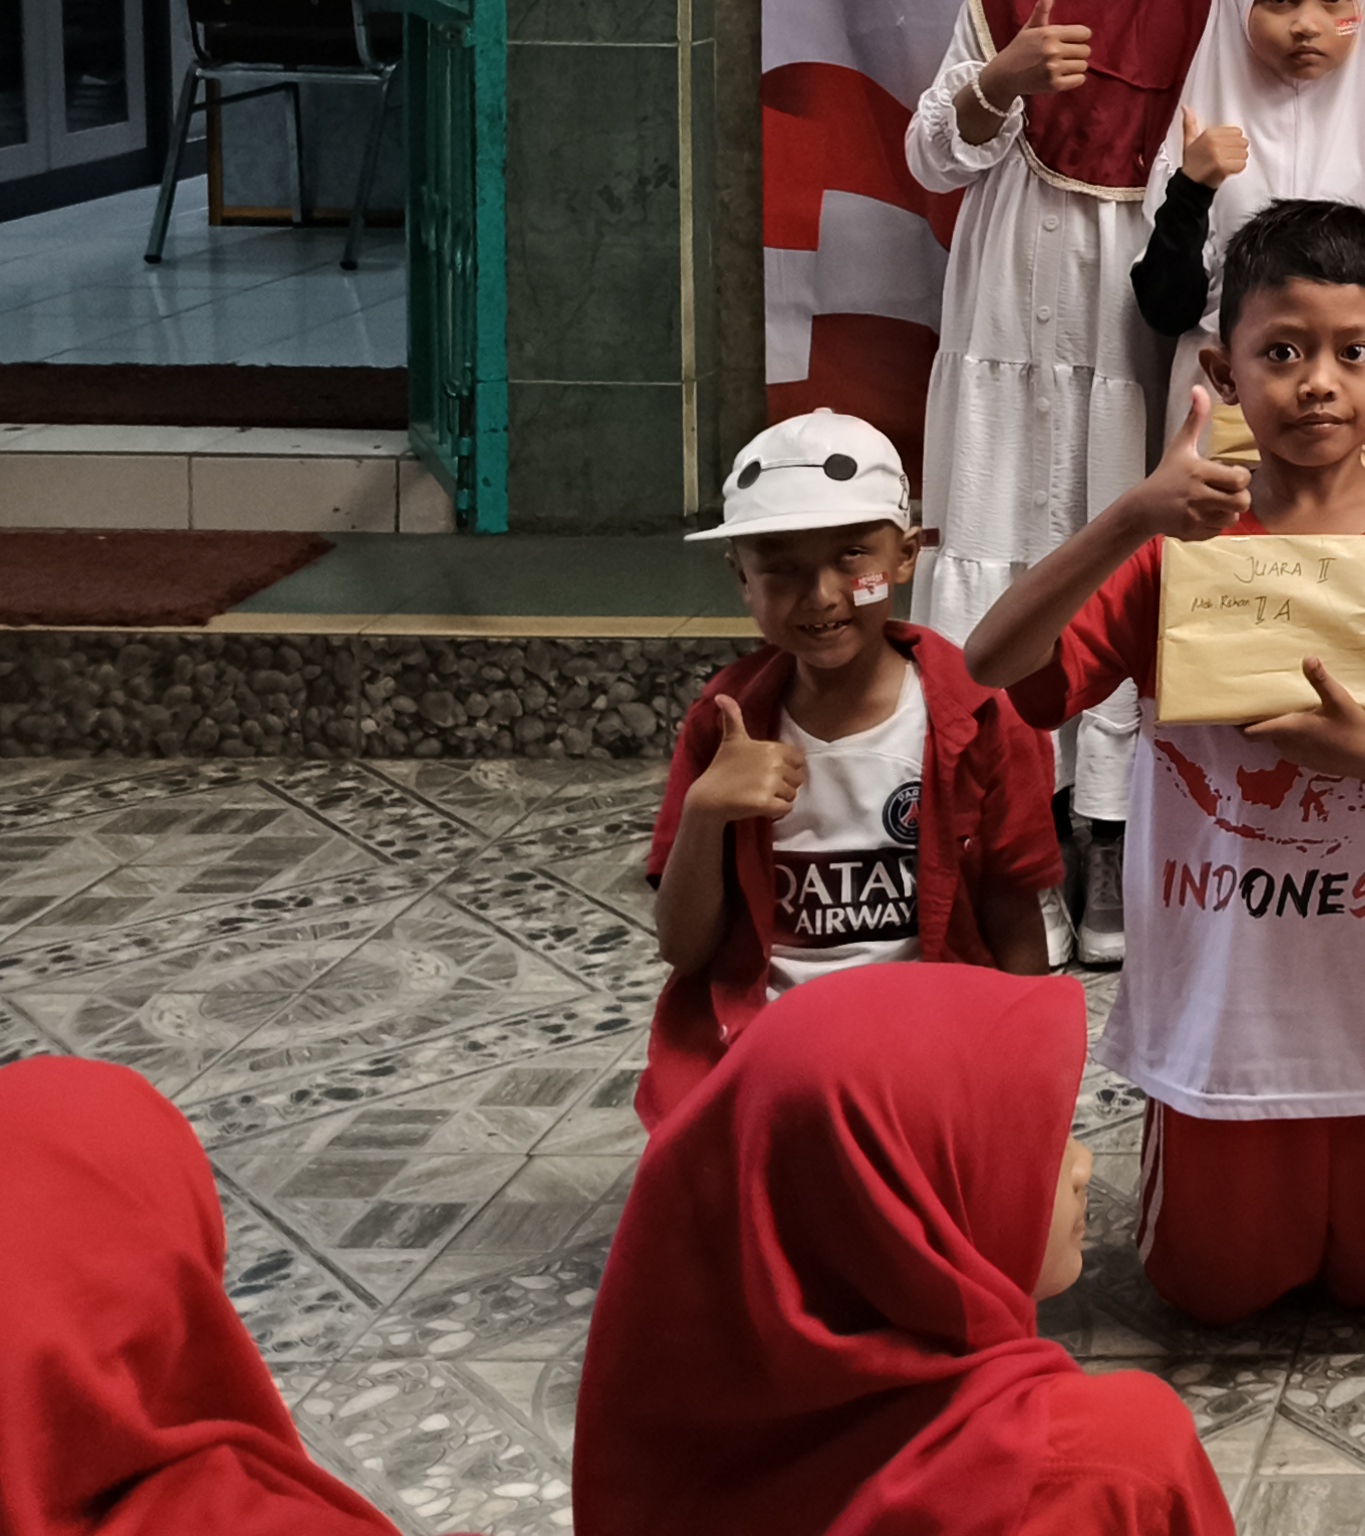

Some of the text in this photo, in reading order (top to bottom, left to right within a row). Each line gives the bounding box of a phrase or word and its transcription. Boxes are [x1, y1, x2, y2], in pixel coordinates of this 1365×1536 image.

[1234, 556, 1302, 583] JUARA
[898, 789, 920, 802] PAR
[795, 902, 916, 935] AIRWAY
